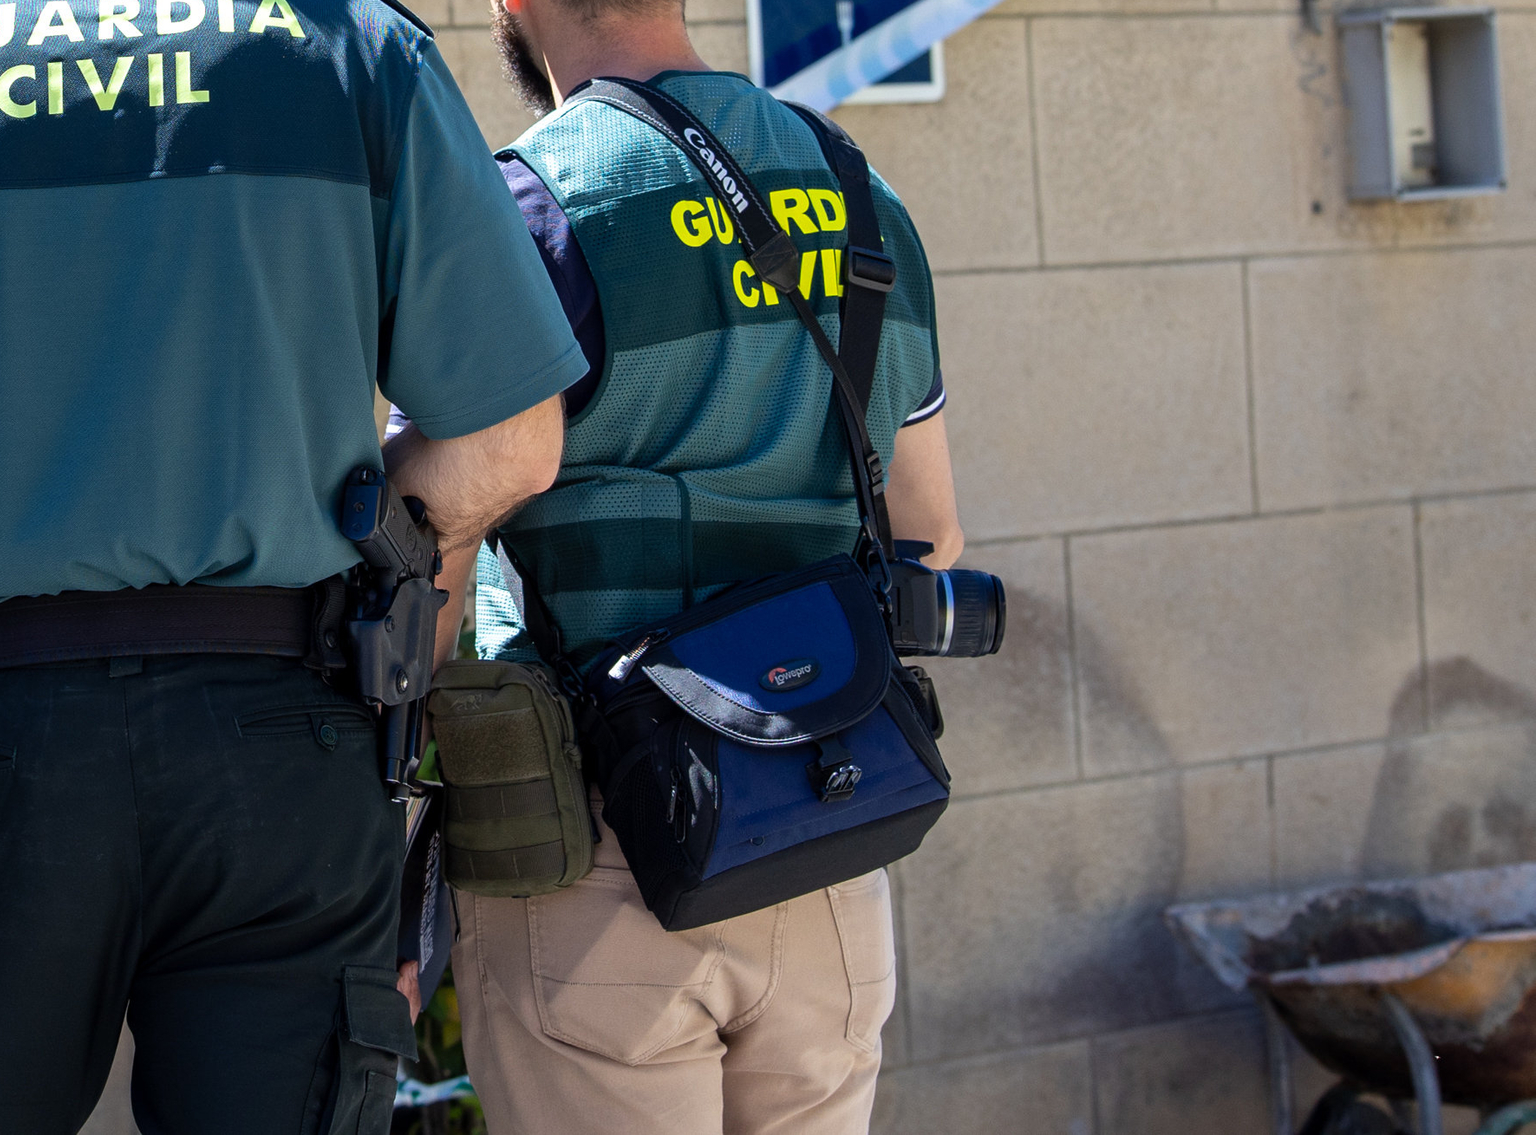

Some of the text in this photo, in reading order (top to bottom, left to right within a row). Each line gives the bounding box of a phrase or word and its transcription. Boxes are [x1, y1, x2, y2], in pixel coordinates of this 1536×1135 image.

[683, 127, 749, 214] Canon
[671, 187, 849, 248] GURD
[774, 664, 812, 686] Lowepro
